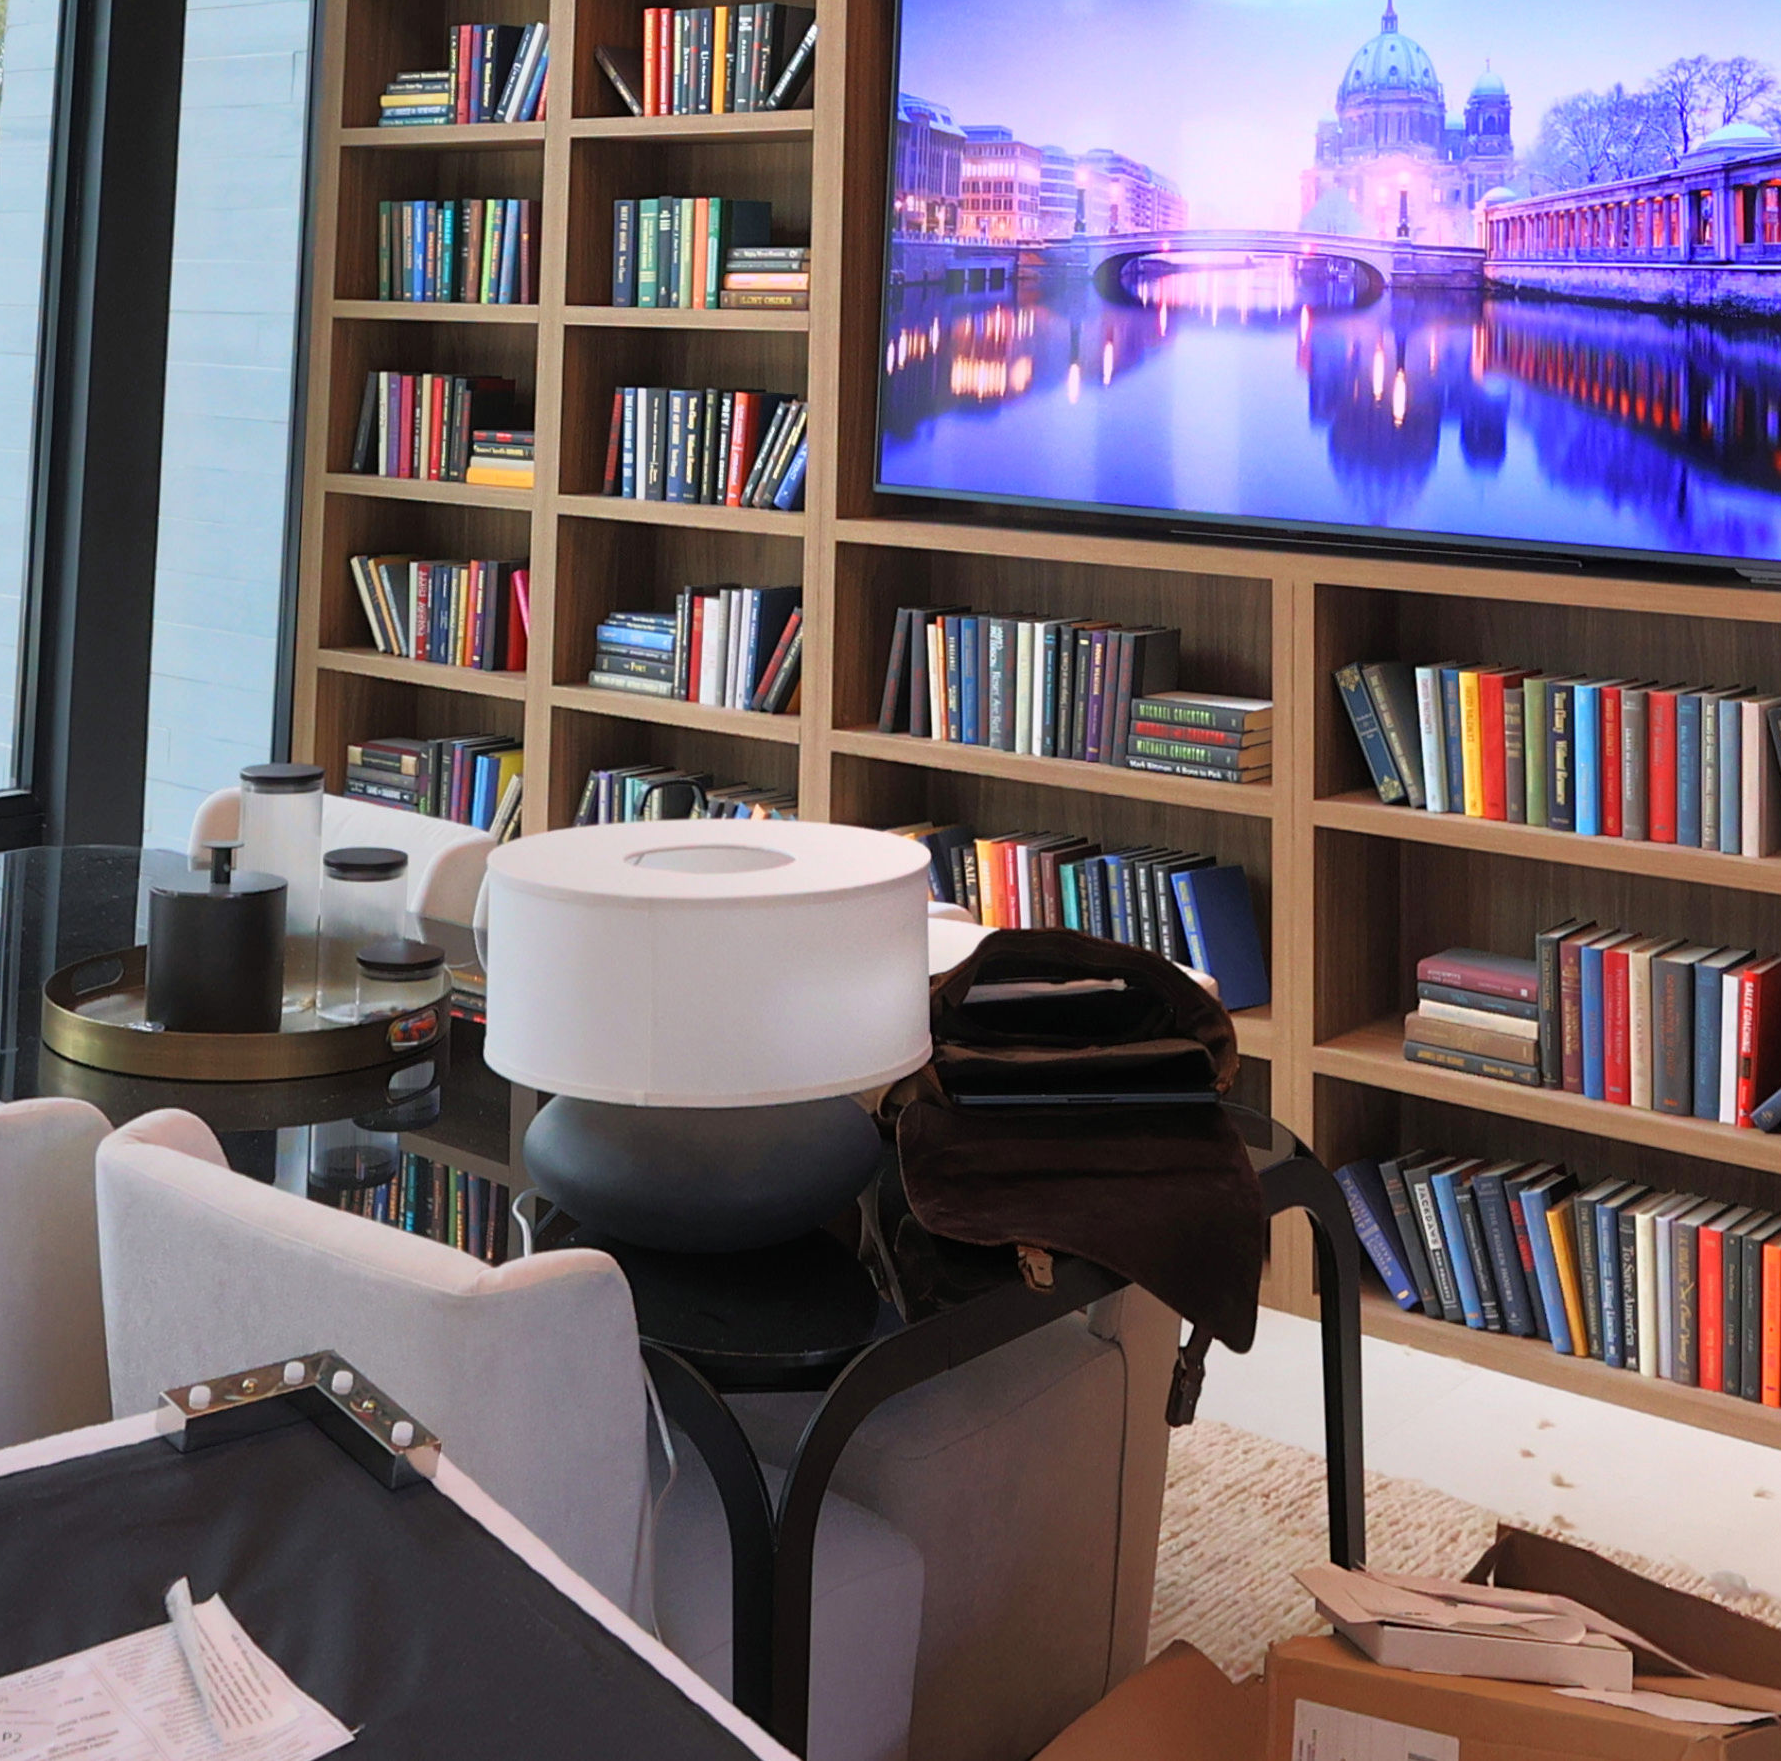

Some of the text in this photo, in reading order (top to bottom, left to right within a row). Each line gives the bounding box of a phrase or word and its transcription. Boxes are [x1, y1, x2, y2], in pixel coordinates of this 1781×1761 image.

[1139, 704, 1172, 719] MICHAEL
[1415, 1185, 1441, 1248] JACKDAWS
[1622, 1245, 1637, 1346] To Save America
[1, 1731, 23, 1744] P2
